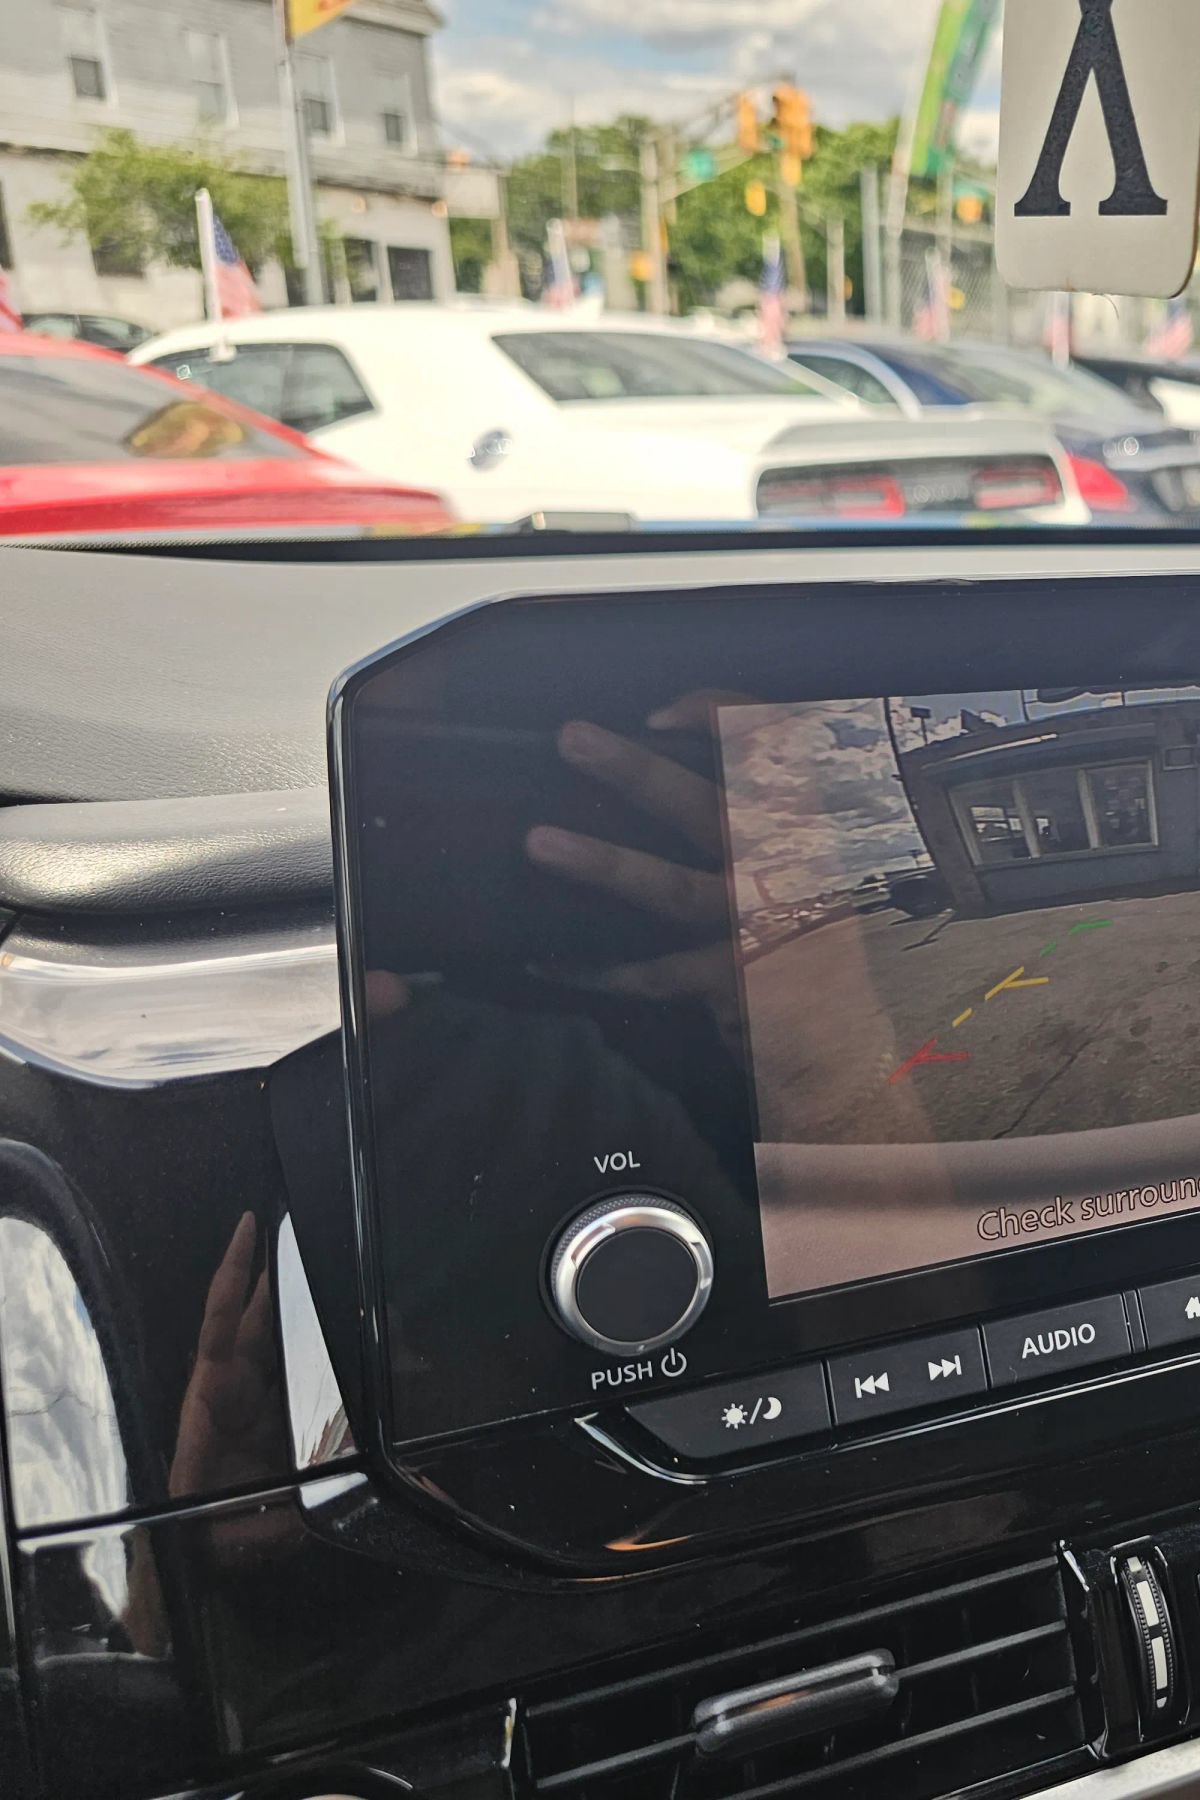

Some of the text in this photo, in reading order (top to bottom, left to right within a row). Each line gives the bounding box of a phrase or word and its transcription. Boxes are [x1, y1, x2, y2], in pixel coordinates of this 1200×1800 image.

[593, 1150, 641, 1174] VOL
[976, 1196, 1075, 1241] Check
[1020, 1322, 1097, 1360] AUDIO
[590, 1360, 654, 1391] PUSH
